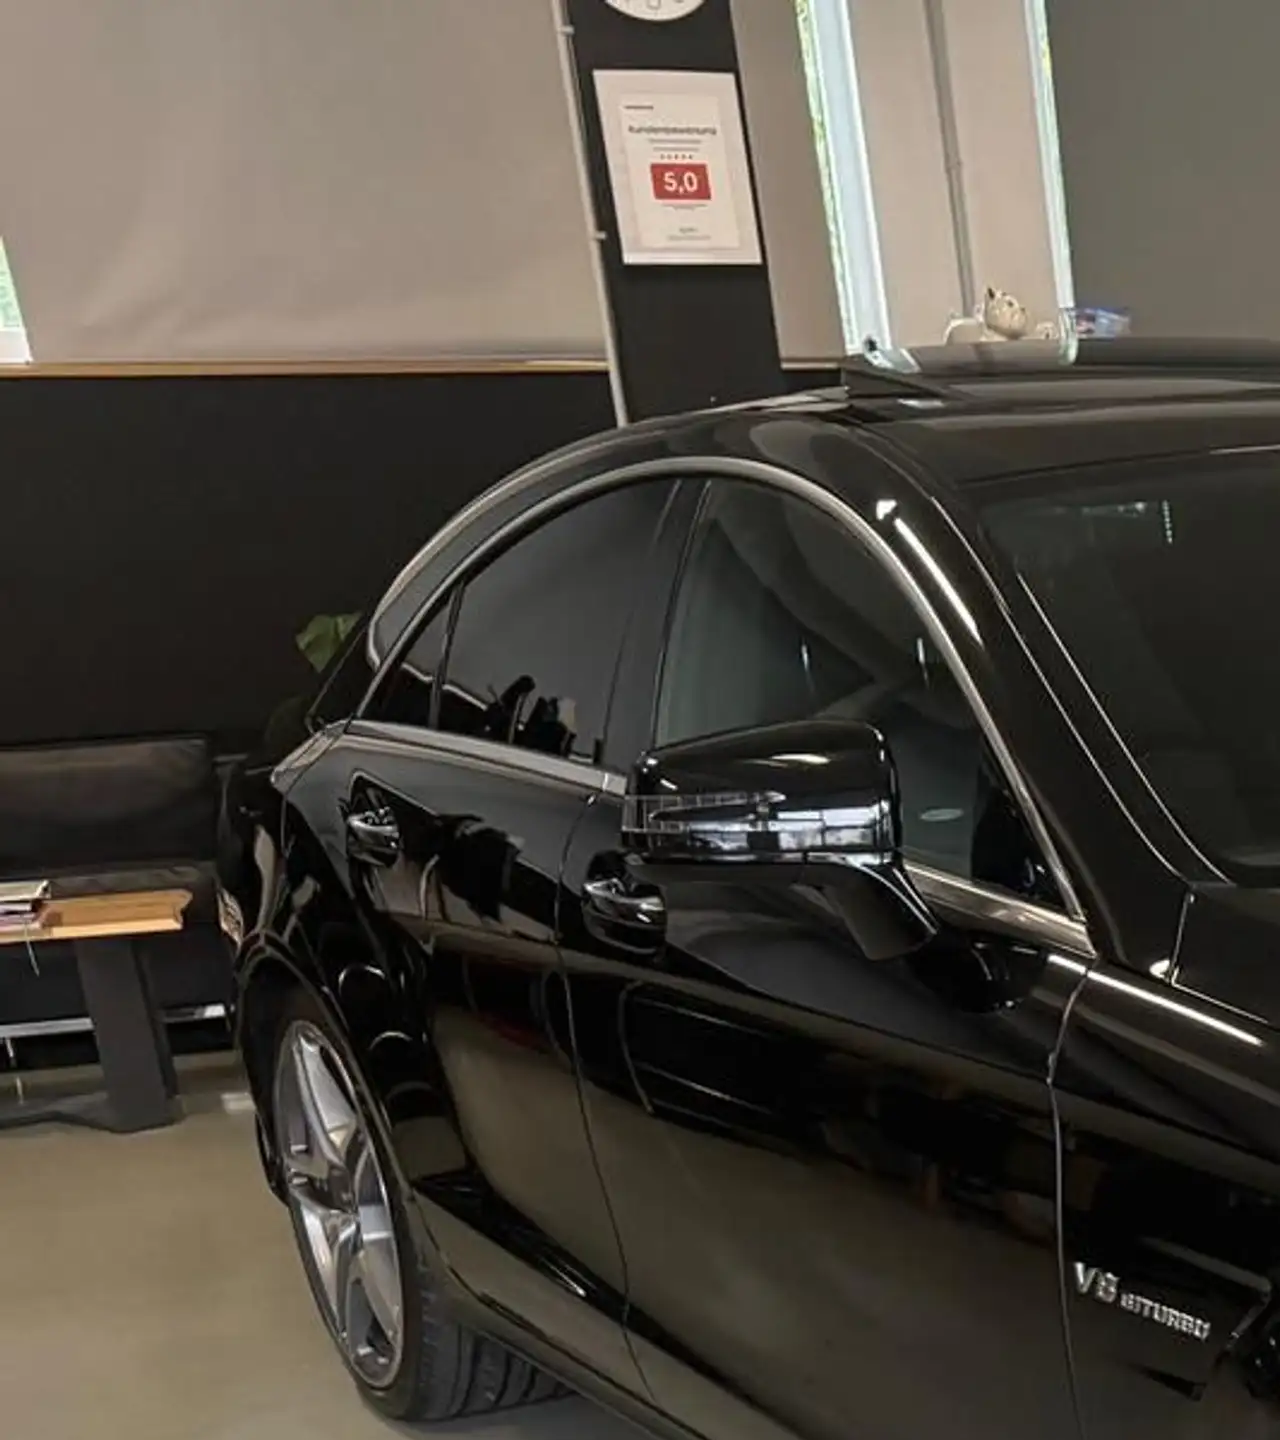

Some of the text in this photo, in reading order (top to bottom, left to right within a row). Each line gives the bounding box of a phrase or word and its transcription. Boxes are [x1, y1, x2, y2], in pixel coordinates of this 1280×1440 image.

[664, 172, 698, 194] 5,0
[1074, 1261, 1211, 1340] V8 BITURBO
